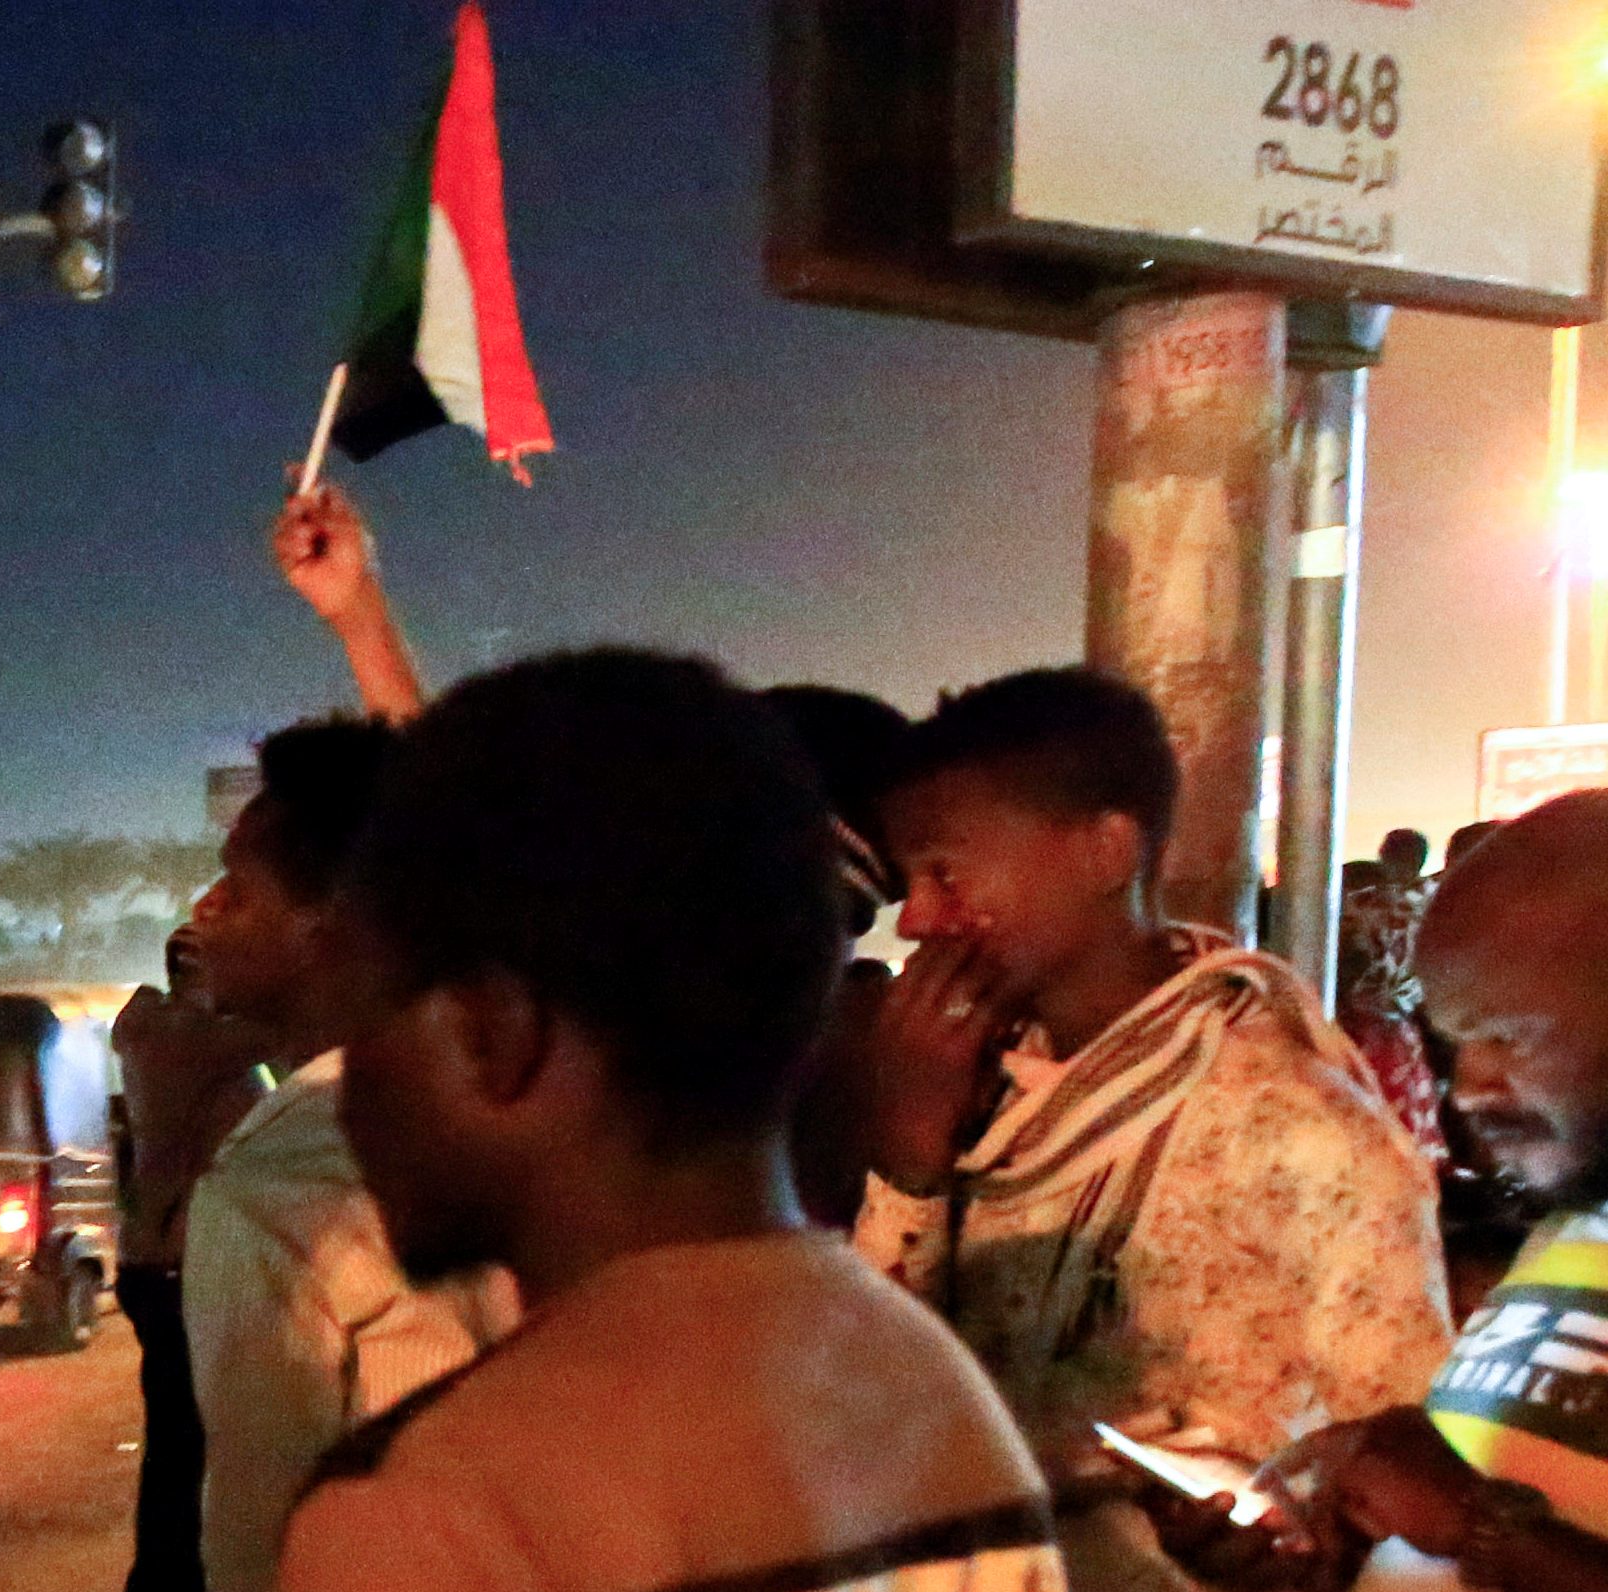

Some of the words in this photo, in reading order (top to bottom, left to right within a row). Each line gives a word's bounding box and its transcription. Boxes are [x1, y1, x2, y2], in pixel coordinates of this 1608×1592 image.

[1262, 34, 1398, 139] 2868
[1255, 141, 1397, 193] الرقم
[1254, 199, 1393, 254] المختصر
